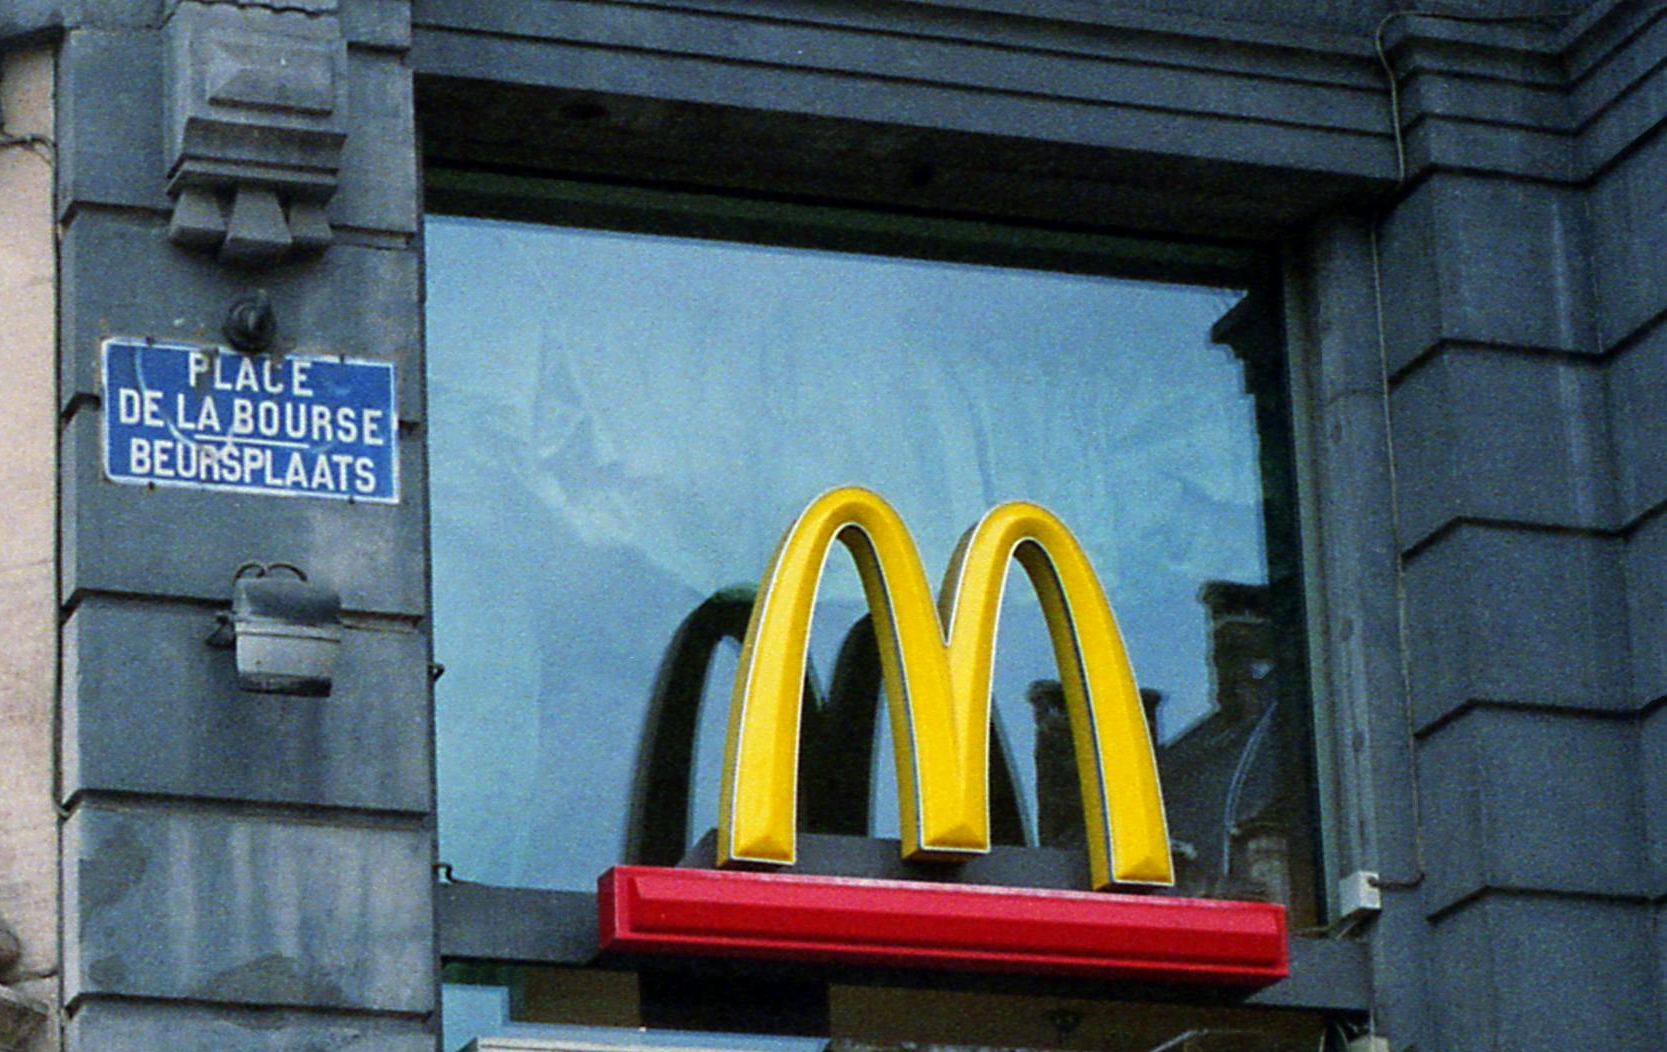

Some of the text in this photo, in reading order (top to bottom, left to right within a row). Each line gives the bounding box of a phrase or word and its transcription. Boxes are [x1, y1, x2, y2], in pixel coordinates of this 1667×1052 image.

[189, 352, 314, 397] PLACE
[118, 388, 384, 446] DE LA BOURSE
[129, 437, 377, 494] BEURSPLAATS
